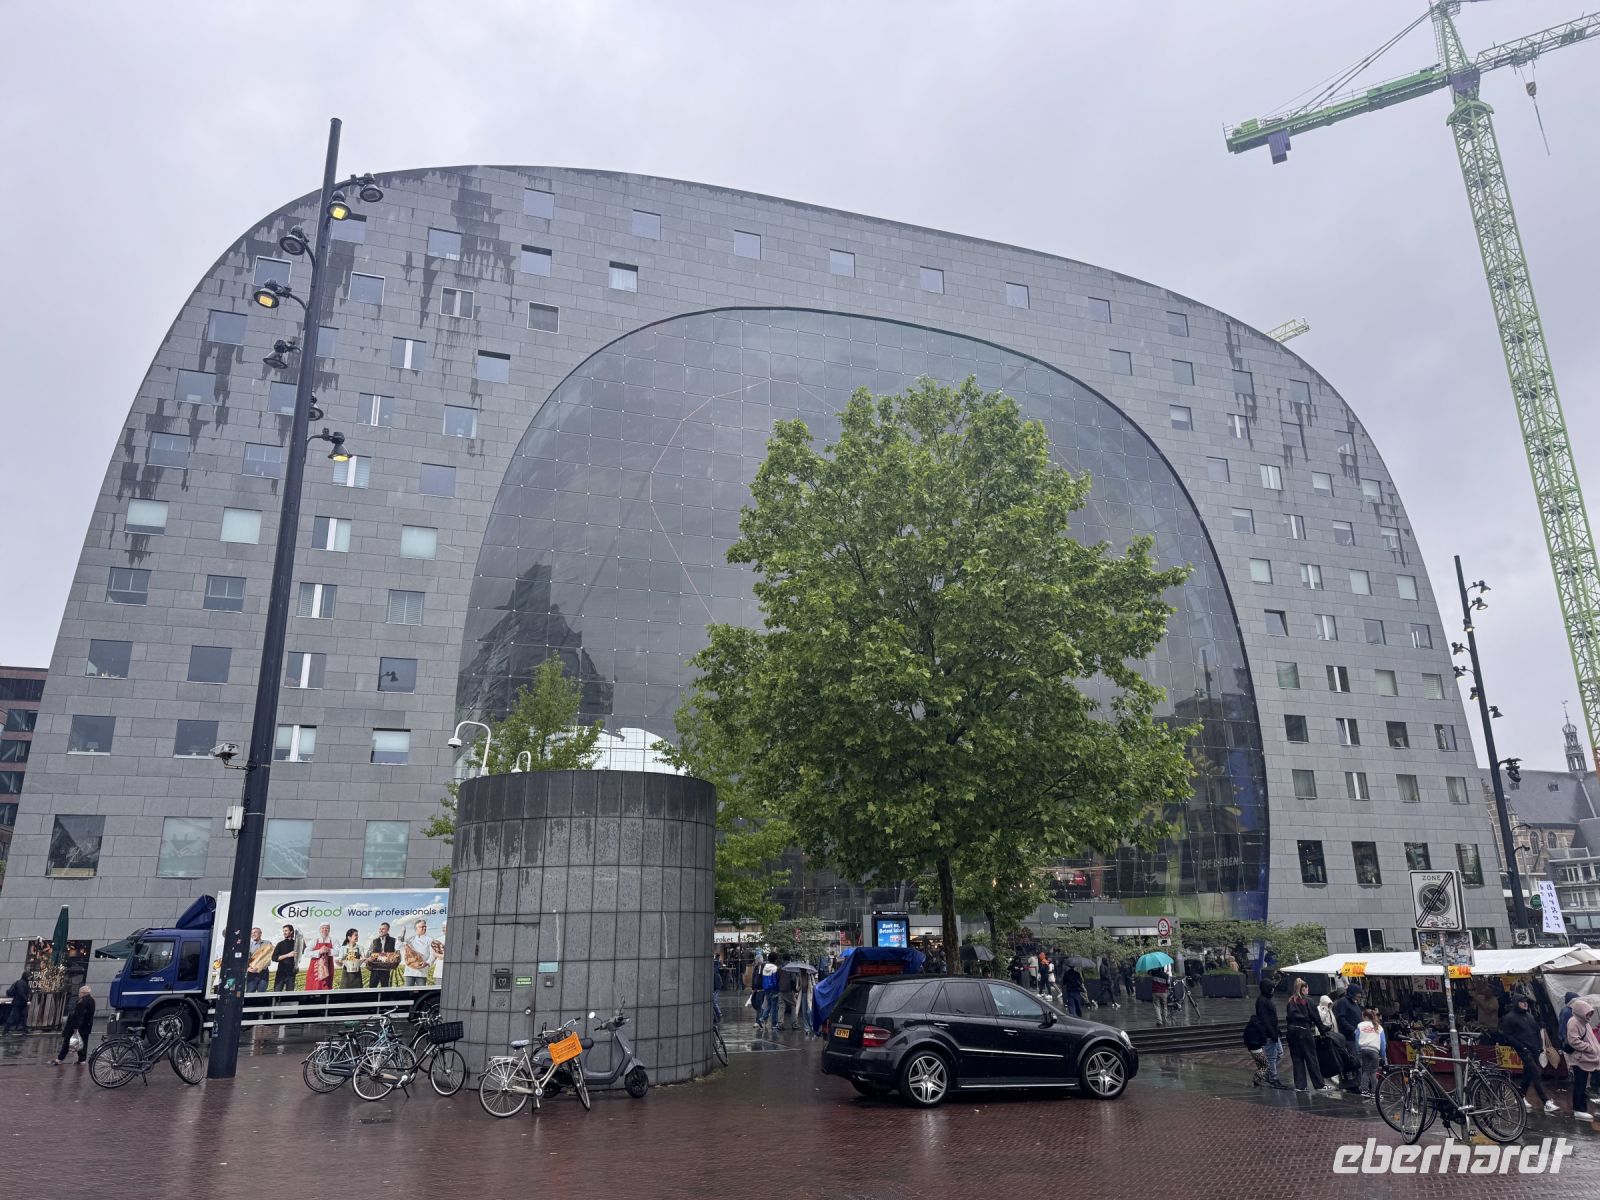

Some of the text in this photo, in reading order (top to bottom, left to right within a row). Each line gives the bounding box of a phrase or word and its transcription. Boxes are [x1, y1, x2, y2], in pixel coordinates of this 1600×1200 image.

[1202, 859, 1212, 868] DE
[288, 906, 342, 918] Bidfood
[348, 908, 373, 917] Waar
[375, 906, 437, 918] professionals
